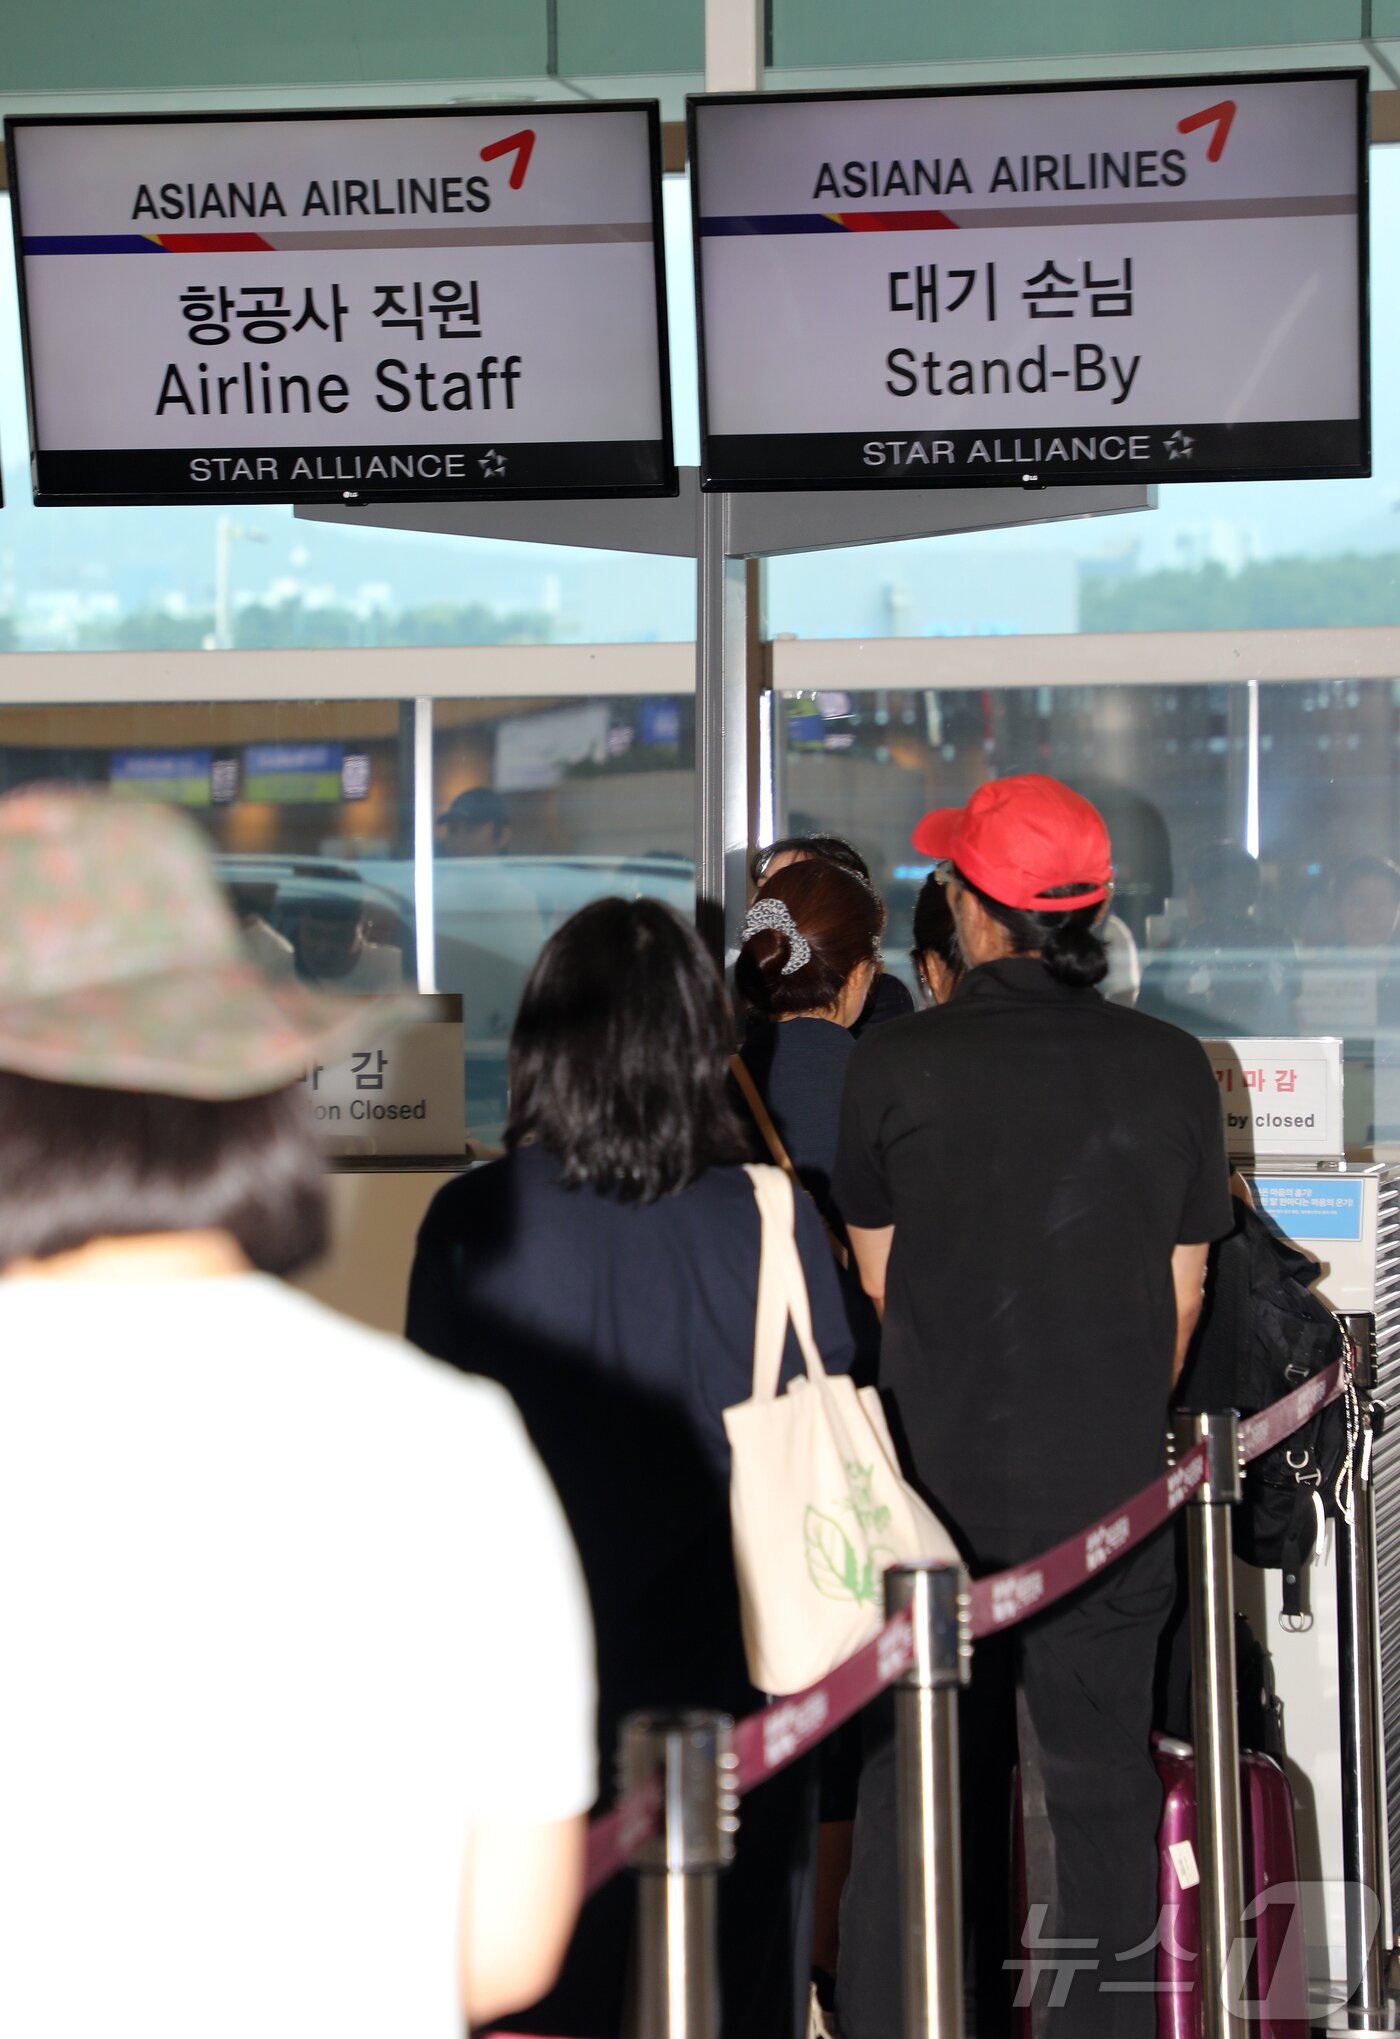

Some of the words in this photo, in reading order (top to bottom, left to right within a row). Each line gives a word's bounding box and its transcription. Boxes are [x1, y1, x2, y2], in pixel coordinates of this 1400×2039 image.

[131, 181, 287, 220] ASIANA
[302, 175, 491, 217] AIRLINES
[812, 157, 973, 199] ASIANA
[989, 148, 1187, 189] AIRLINES
[179, 283, 349, 346] 항공사
[372, 279, 483, 342] 직원
[888, 261, 997, 324] 대기
[1021, 256, 1134, 320] 손님
[154, 360, 350, 416] Airline
[374, 355, 523, 413] Staff
[885, 343, 1142, 405] Stand-By
[189, 456, 279, 483] STAR
[289, 453, 467, 482] ALLIANCE
[862, 439, 956, 467] STAR
[966, 434, 1152, 465] ALLIANCE
[350, 1099, 427, 1121] Closed
[1254, 1112, 1316, 1128] closed
